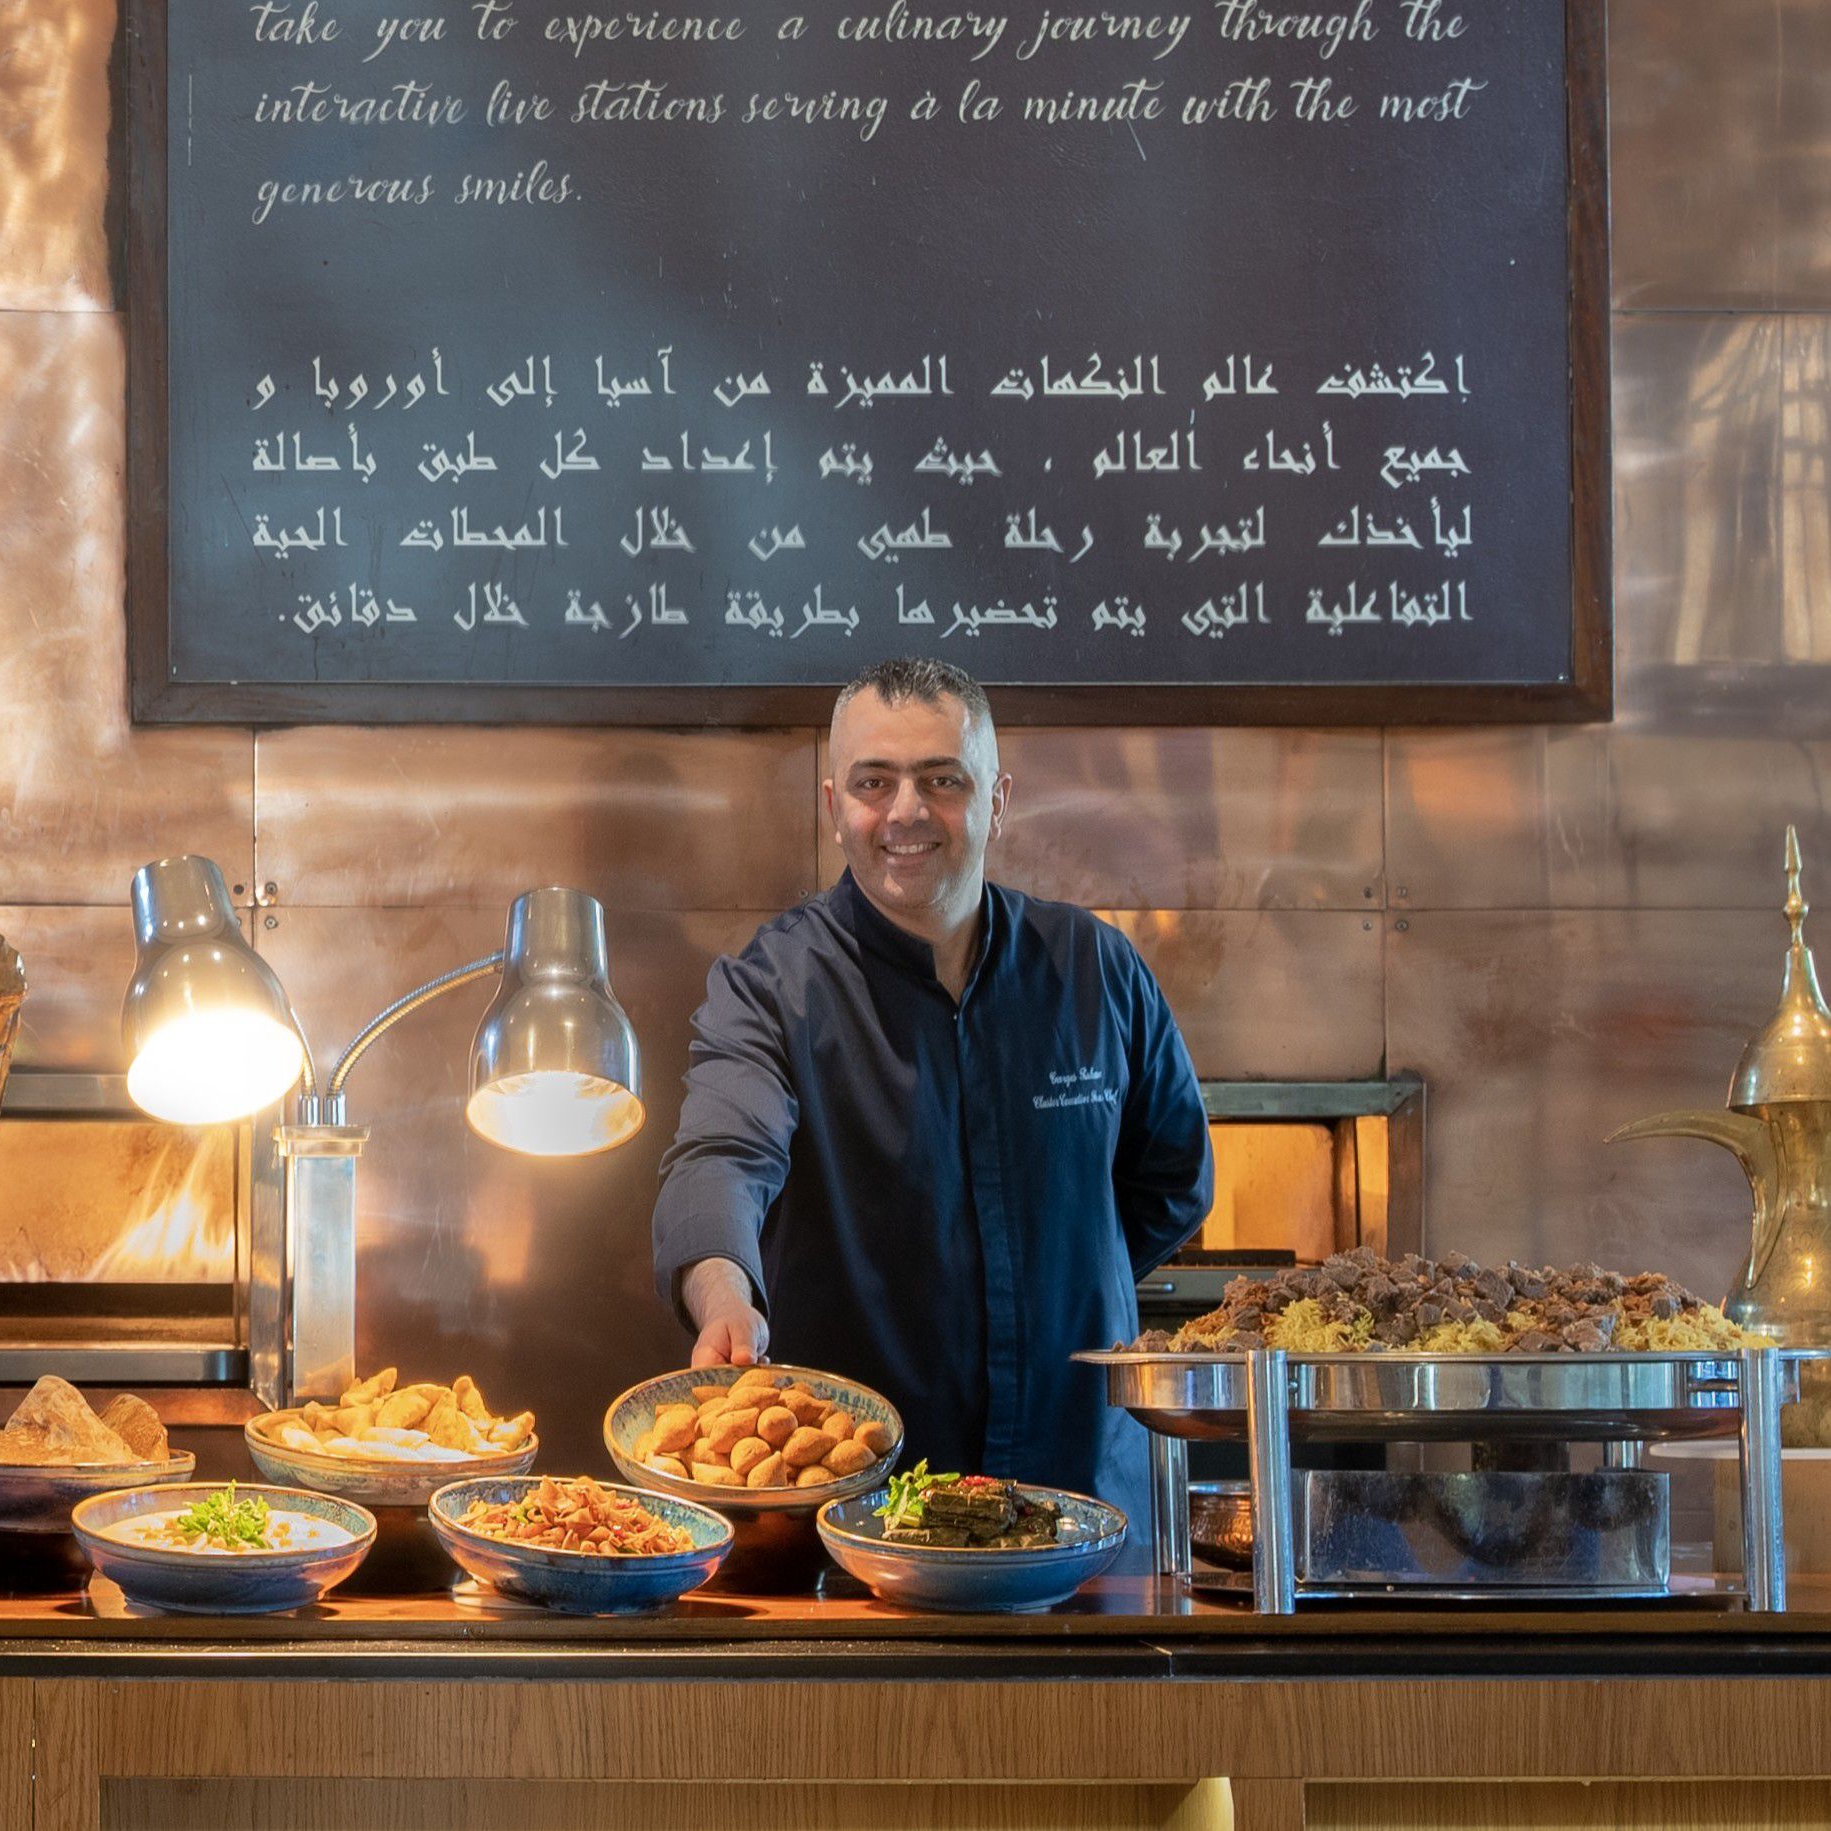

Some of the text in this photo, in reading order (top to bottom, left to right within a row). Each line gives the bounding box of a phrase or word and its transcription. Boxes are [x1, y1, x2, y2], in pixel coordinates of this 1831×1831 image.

[249, 0, 1468, 63] take you to experience a culinary journey through the
[254, 75, 1490, 142] interactive live stations serving à la minute with the most
[251, 159, 583, 225] generous smiles.
[252, 373, 276, 411] و
[312, 346, 451, 410] أوروبا
[485, 354, 559, 408] إلى
[594, 345, 677, 408] آسيا
[712, 371, 772, 408] من
[806, 353, 955, 410] المميزة
[989, 351, 1168, 402] النكهات
[1202, 353, 1280, 402] عالم
[252, 422, 378, 484] بأصالة
[417, 429, 499, 483] طبق
[539, 427, 603, 480] كل
[641, 428, 779, 485] إعداد
[818, 442, 874, 486] يتم
[914, 435, 1003, 486] حيث
[1242, 419, 1341, 476] أنحاء
[1379, 445, 1472, 490] جميع
[252, 496, 1474, 564] ليأخذك لتجربة رحلة طهي من خلال المحطات الحية
[278, 580, 1474, 640] التفاعلية التي يتم تحضيرها بطريقة طازجة خلال دقائق.
